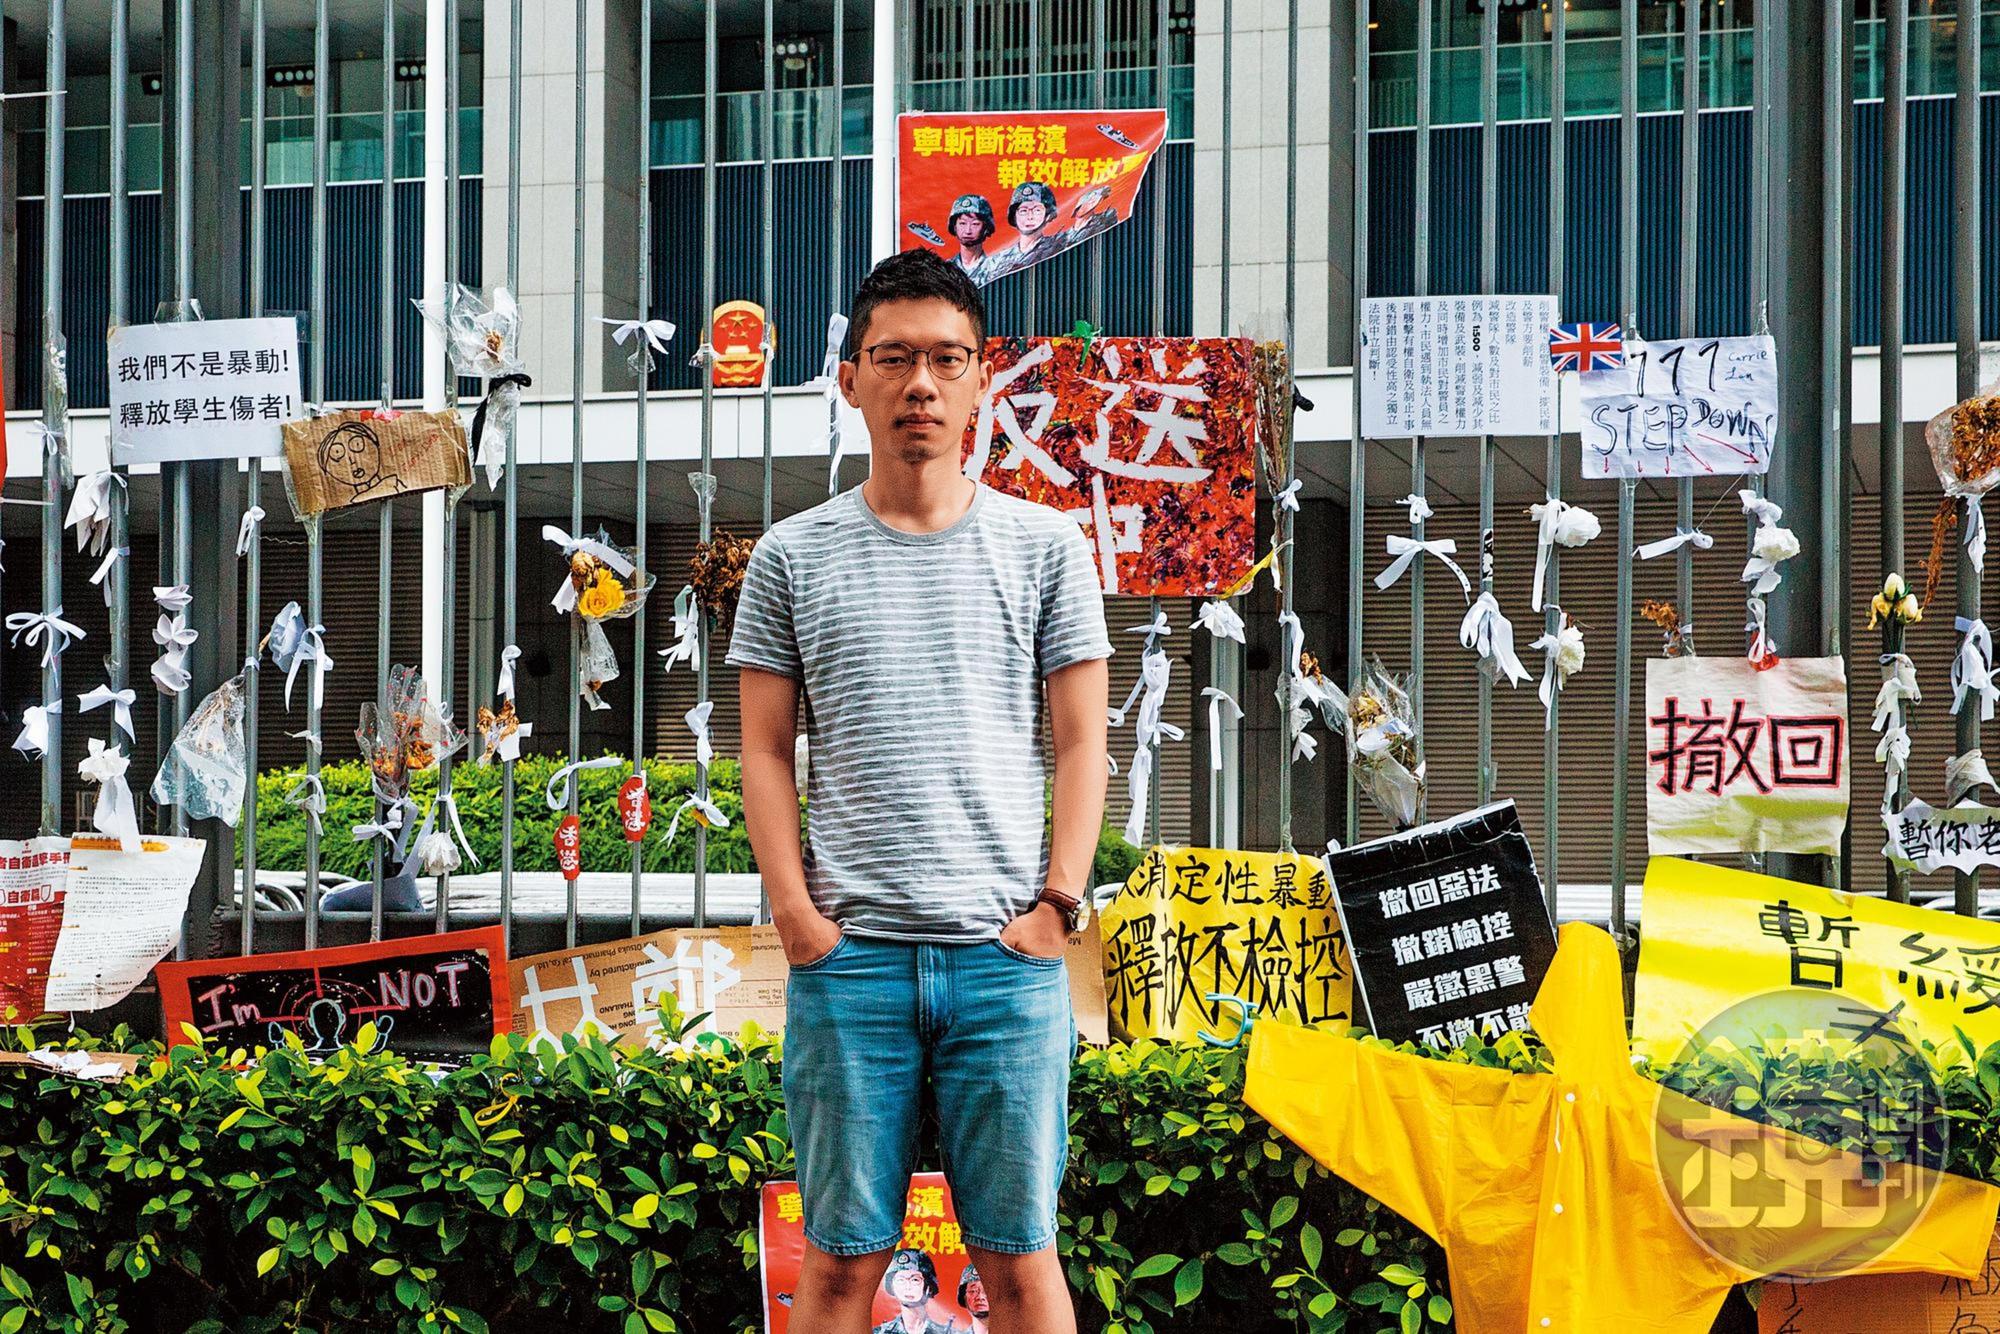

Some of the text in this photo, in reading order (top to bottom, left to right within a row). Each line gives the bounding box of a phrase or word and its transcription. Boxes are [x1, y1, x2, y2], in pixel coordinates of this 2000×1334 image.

[913, 125, 1067, 156] 寧斬斷海濱
[118, 348, 289, 382] 我們不是暴動!
[120, 393, 291, 428] 釋放學生傷者!
[1591, 398, 1773, 458] STEP DOWN
[1649, 696, 1844, 796] 撤回
[1378, 864, 1502, 919] 撤回惡法
[1391, 911, 1515, 966] 撤銷檢控
[379, 961, 469, 1009] NOT
[1107, 912, 1348, 1030] 釋放不檢控
[1403, 955, 1527, 1011] 嚴懲黑警
[599, 1001, 634, 1014] THAILAND
